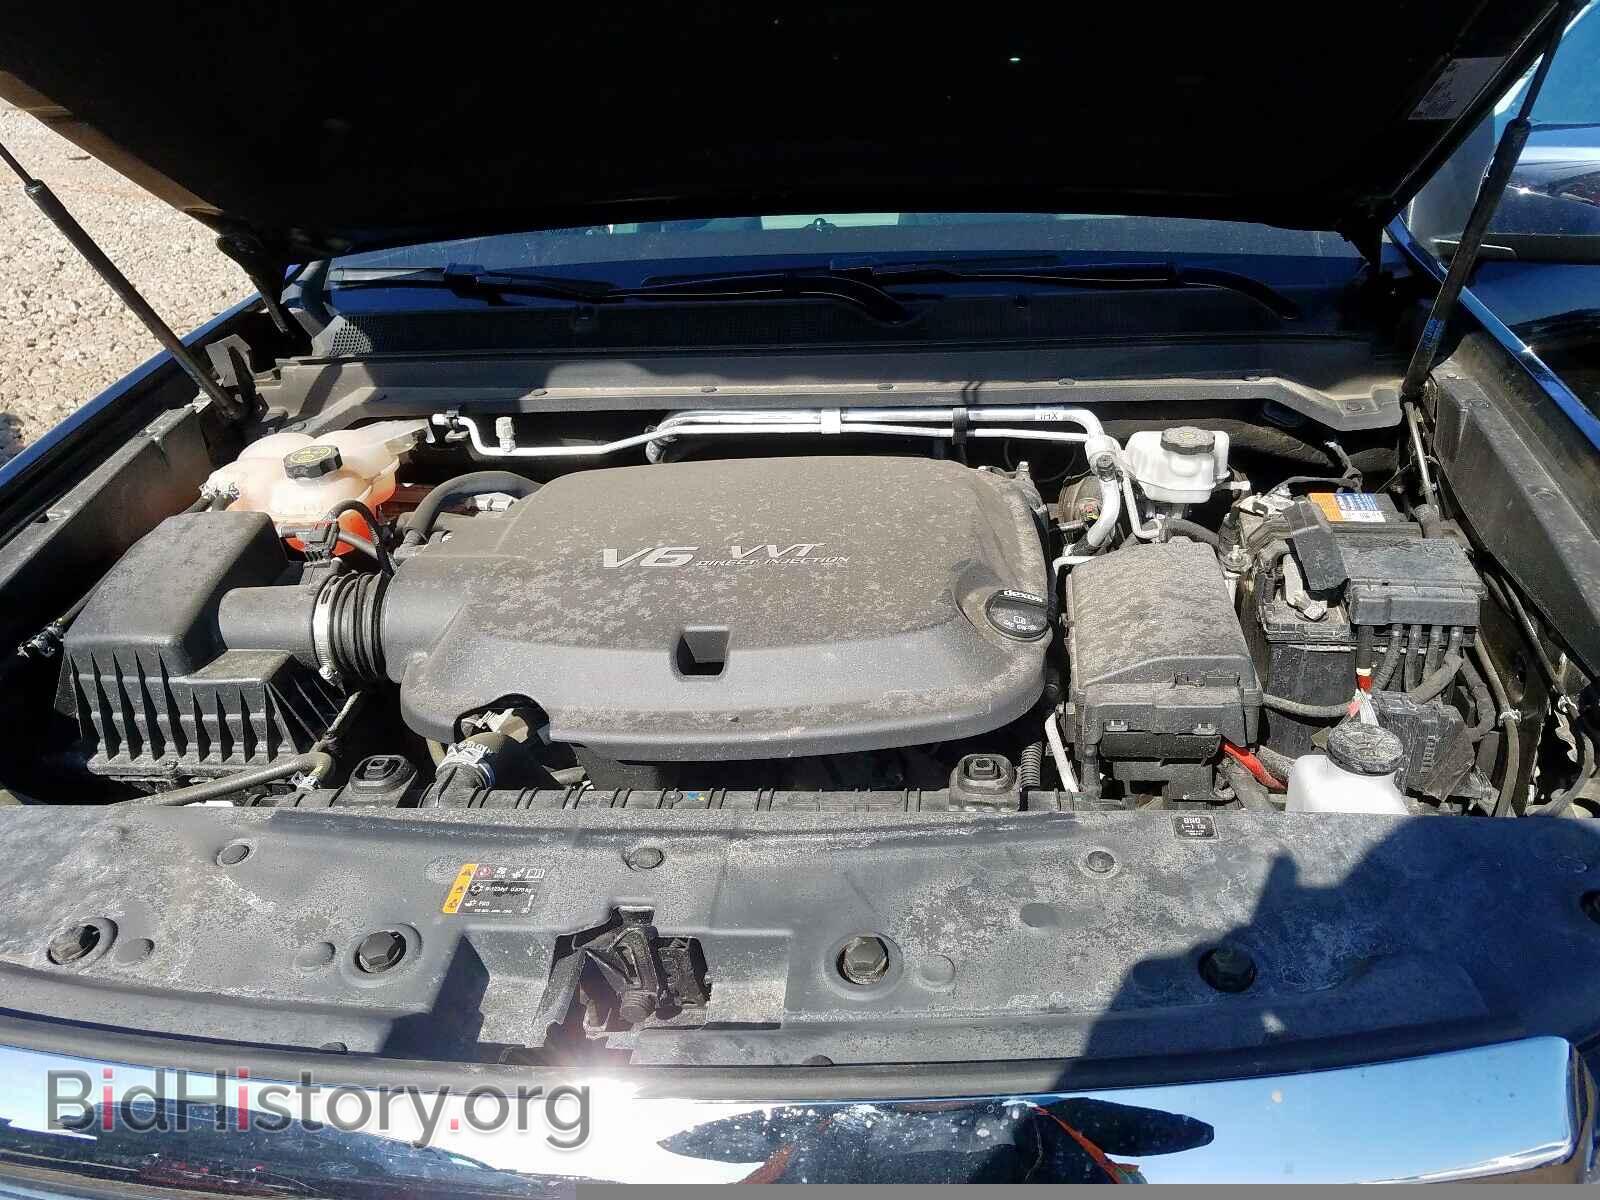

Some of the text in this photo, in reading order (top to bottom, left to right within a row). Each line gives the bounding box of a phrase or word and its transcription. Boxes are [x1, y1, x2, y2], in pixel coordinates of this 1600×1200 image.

[603, 546, 700, 568] V6
[731, 543, 826, 559] VVT
[696, 556, 850, 567] DIRECT INJECTION
